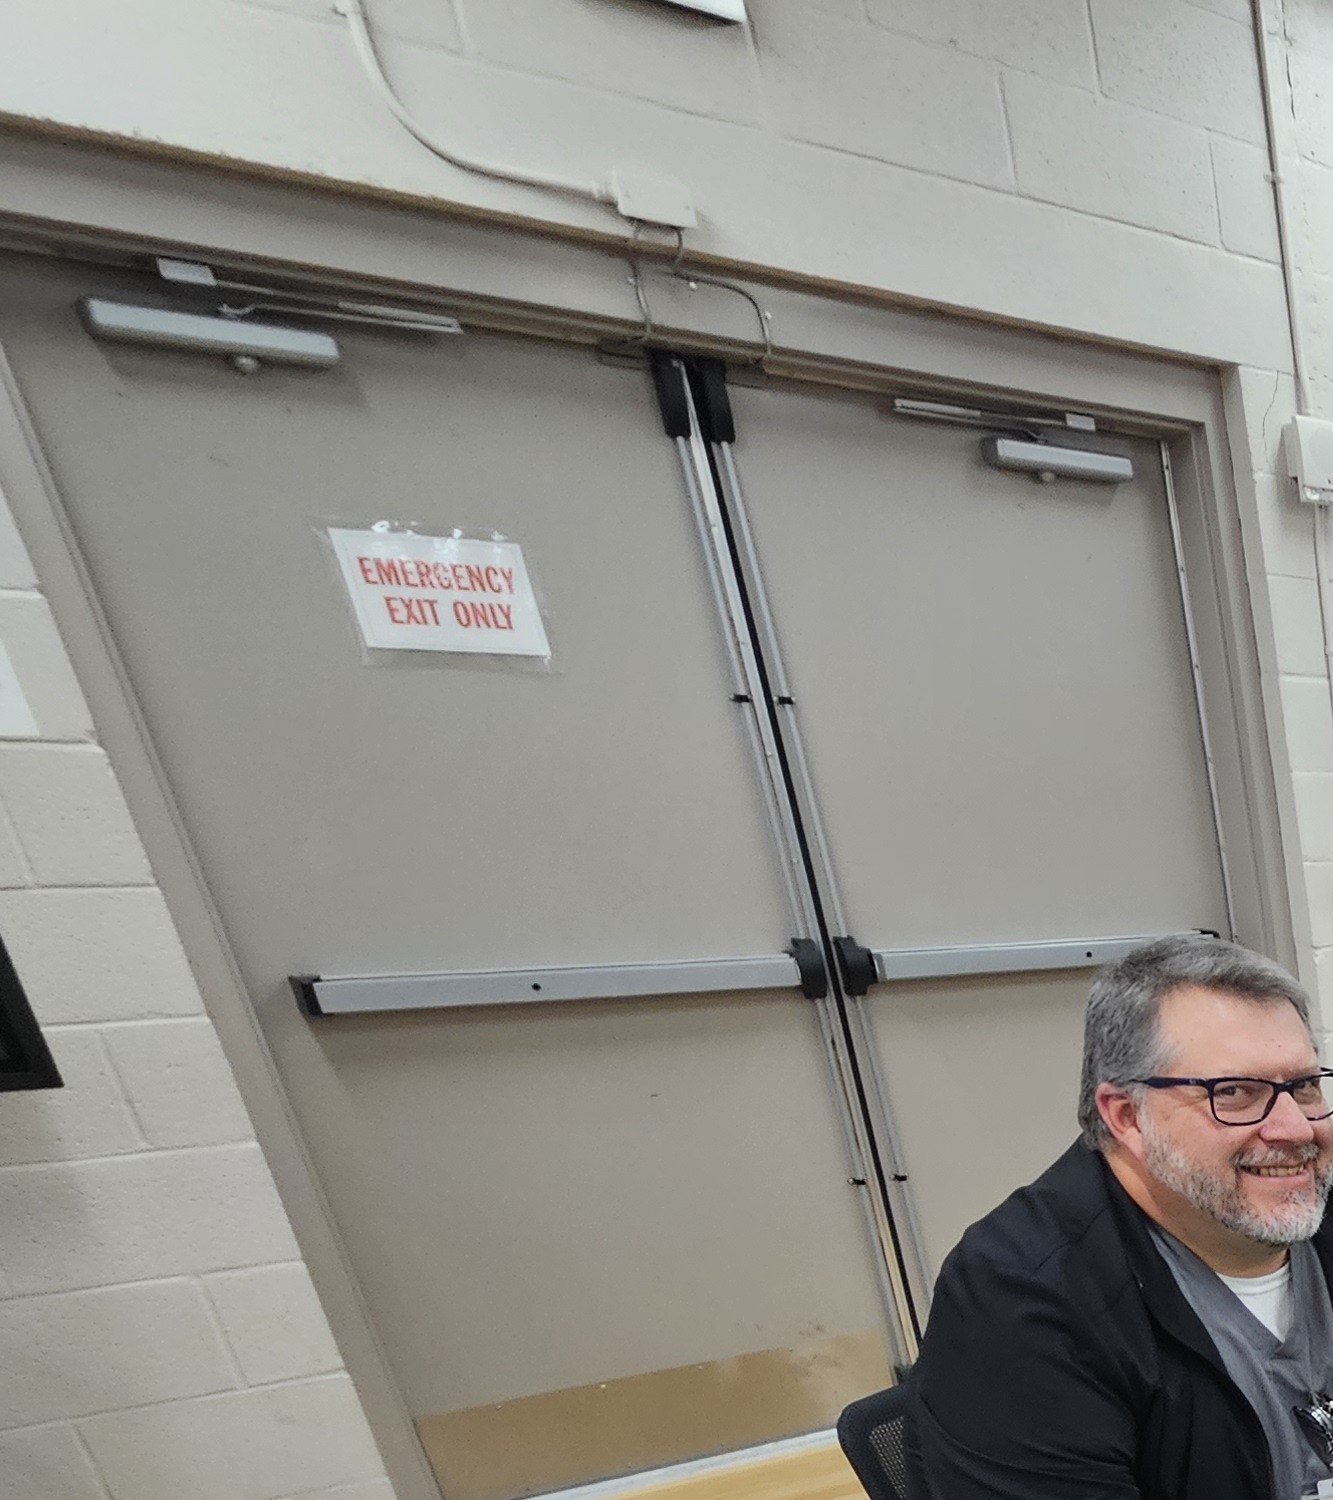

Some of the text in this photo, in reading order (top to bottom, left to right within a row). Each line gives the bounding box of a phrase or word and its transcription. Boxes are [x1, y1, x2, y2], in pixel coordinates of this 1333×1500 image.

[357, 556, 516, 594] EMERGENCY
[384, 596, 514, 630] EXIT ONLY
